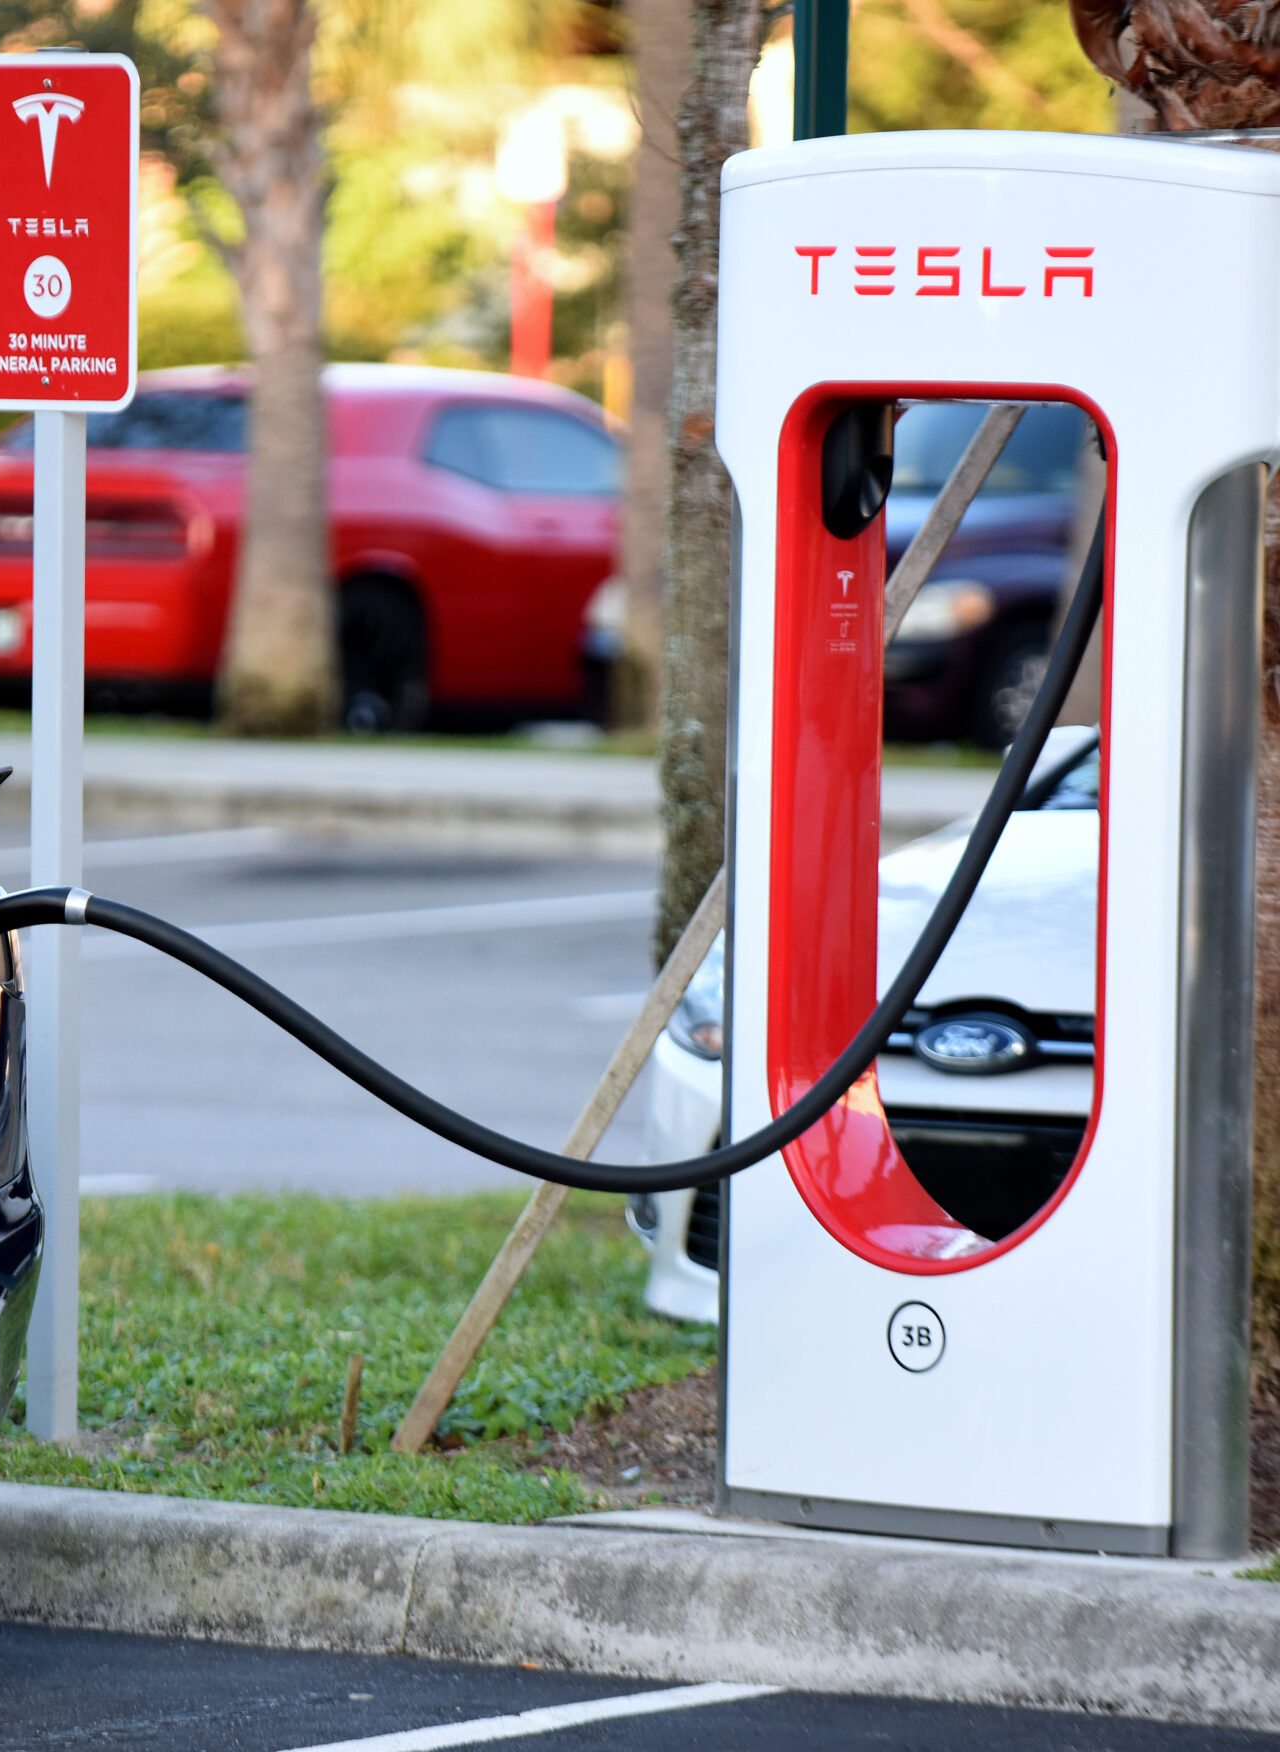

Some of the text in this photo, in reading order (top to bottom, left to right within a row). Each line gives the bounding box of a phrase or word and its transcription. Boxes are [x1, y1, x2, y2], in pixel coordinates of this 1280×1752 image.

[7, 217, 89, 236] TESLA
[794, 246, 1095, 298] TESLA
[32, 274, 63, 298] 30
[8, 333, 87, 350] 30 MINUTE
[50, 357, 117, 374] PARKING
[902, 1325, 932, 1347] 3B
